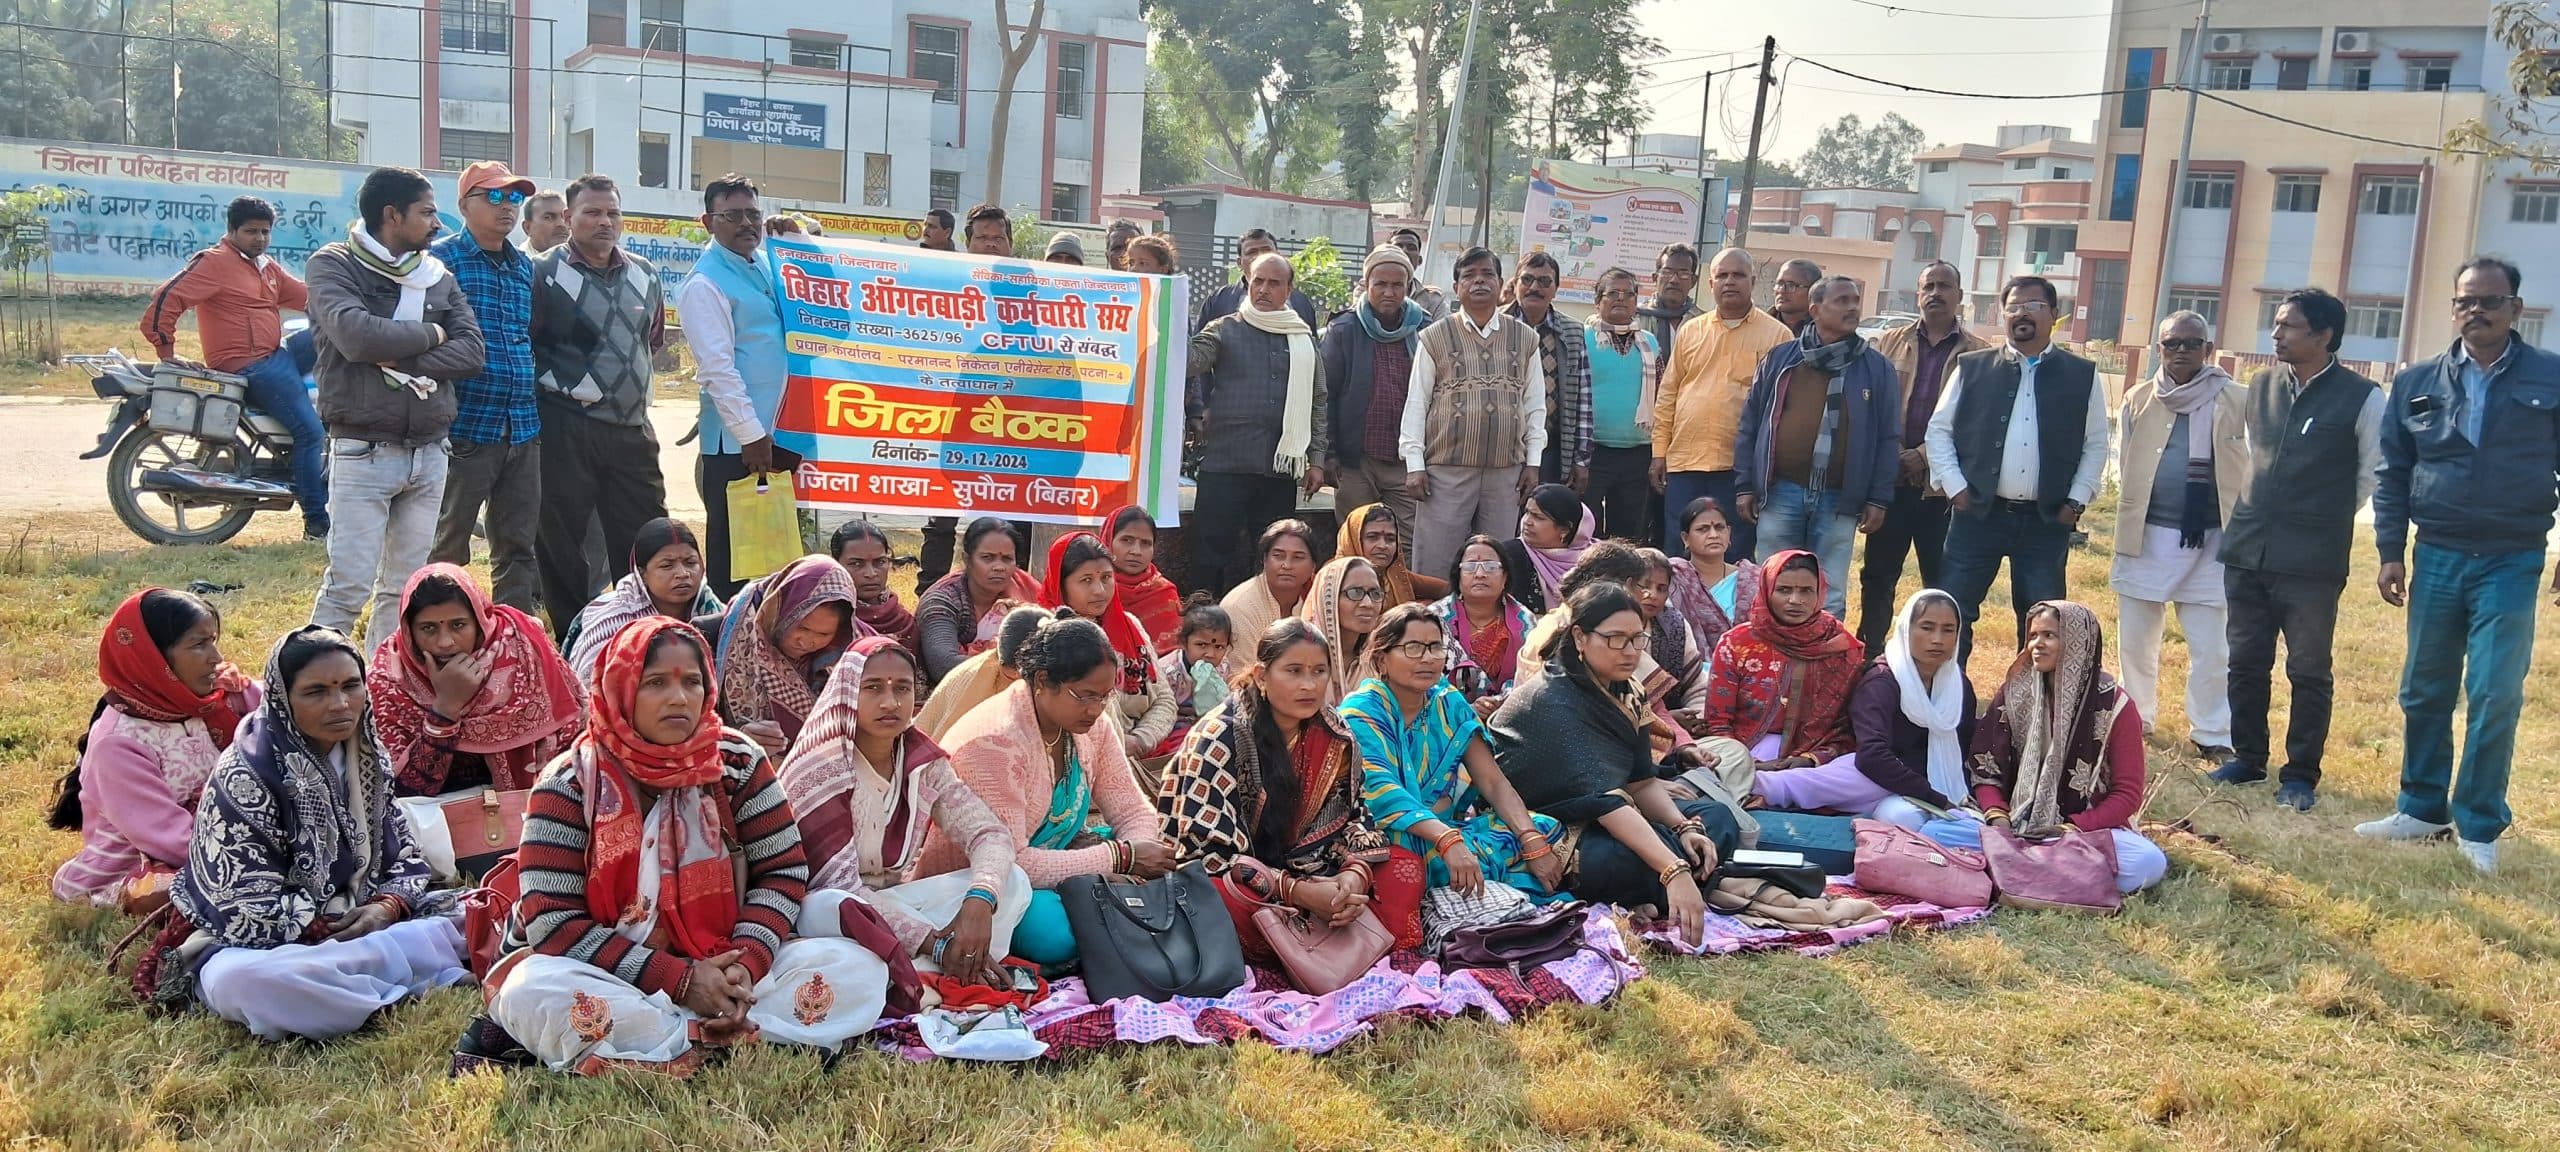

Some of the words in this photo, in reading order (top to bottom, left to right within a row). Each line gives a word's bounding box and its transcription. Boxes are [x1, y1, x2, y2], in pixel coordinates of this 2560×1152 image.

[706, 111, 739, 131] जिला
[37, 147, 113, 175] जिला
[117, 154, 204, 183] परिवहन
[204, 163, 290, 189] कार्यालय
[100, 196, 152, 220] अगर
[155, 194, 218, 223] आपको
[776, 247, 834, 265] इनकलाब
[839, 253, 899, 272] जिन्दाबाद
[782, 264, 850, 309] बिहार
[994, 291, 1087, 329] कर्मचारी
[1094, 296, 1133, 332] संघ
[1054, 279, 1080, 290] एकता
[799, 309, 851, 332] निबन्धन
[983, 334, 1053, 351] CFTUI
[1060, 336, 1073, 352] से
[1078, 337, 1118, 359] संबद्ध
[795, 339, 828, 354] प्रधान
[832, 344, 881, 361] कार्यालय
[898, 354, 952, 369] परमानन्द
[956, 354, 1000, 371] निकेतन
[920, 373, 933, 387] के
[938, 378, 998, 391] तत्वाधान
[1002, 378, 1014, 391] में
[824, 382, 961, 435] जिला
[969, 395, 1092, 443] बैठक
[945, 450, 1028, 469] 29.12.2024
[796, 463, 859, 493] जिला
[951, 475, 1017, 506] सुपौल
[1025, 478, 1098, 510] (बिहार)
